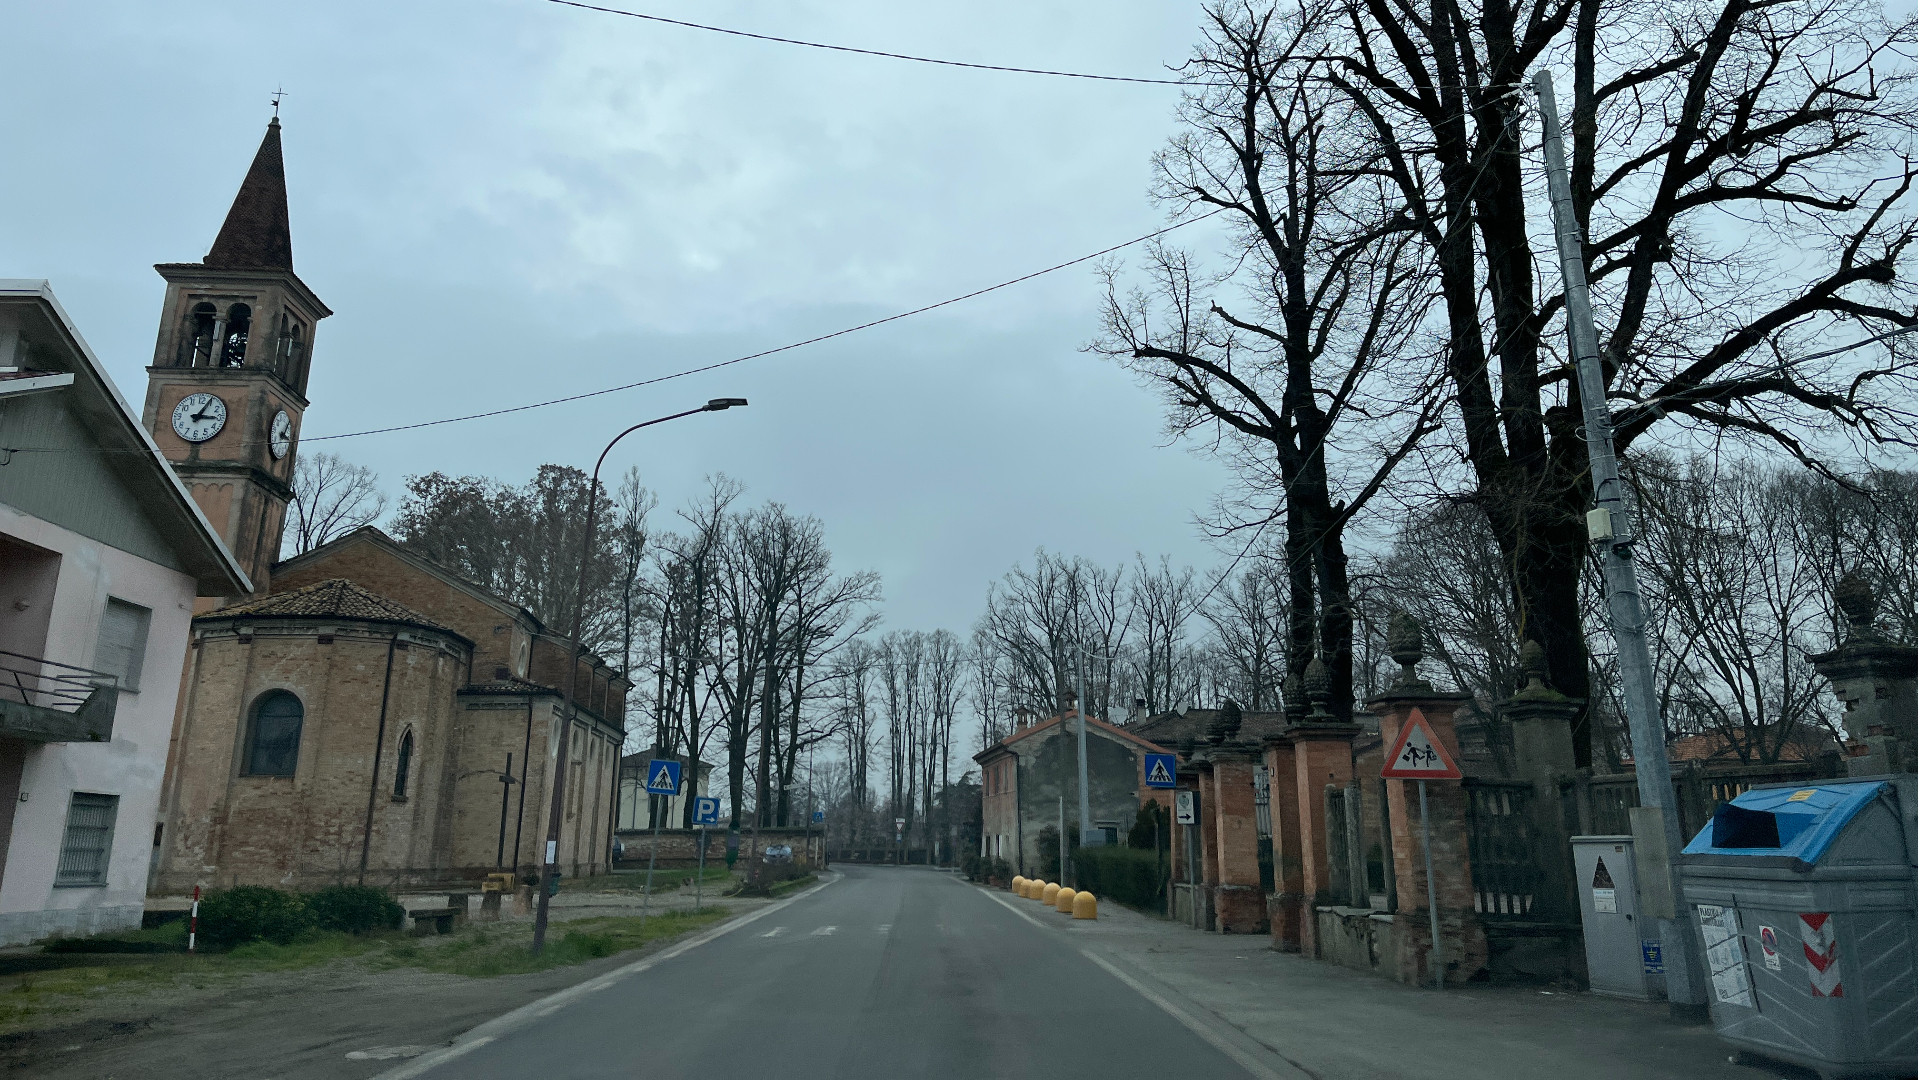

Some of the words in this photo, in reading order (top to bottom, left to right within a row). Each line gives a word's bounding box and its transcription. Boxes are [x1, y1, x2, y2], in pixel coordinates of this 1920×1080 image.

[198, 396, 206, 404] 12
[216, 413, 222, 421] 3
[210, 422, 217, 430] 4
[184, 428, 190, 436] 7
[192, 430, 198, 438] 6
[202, 428, 209, 436] 5
[697, 800, 715, 821] P
